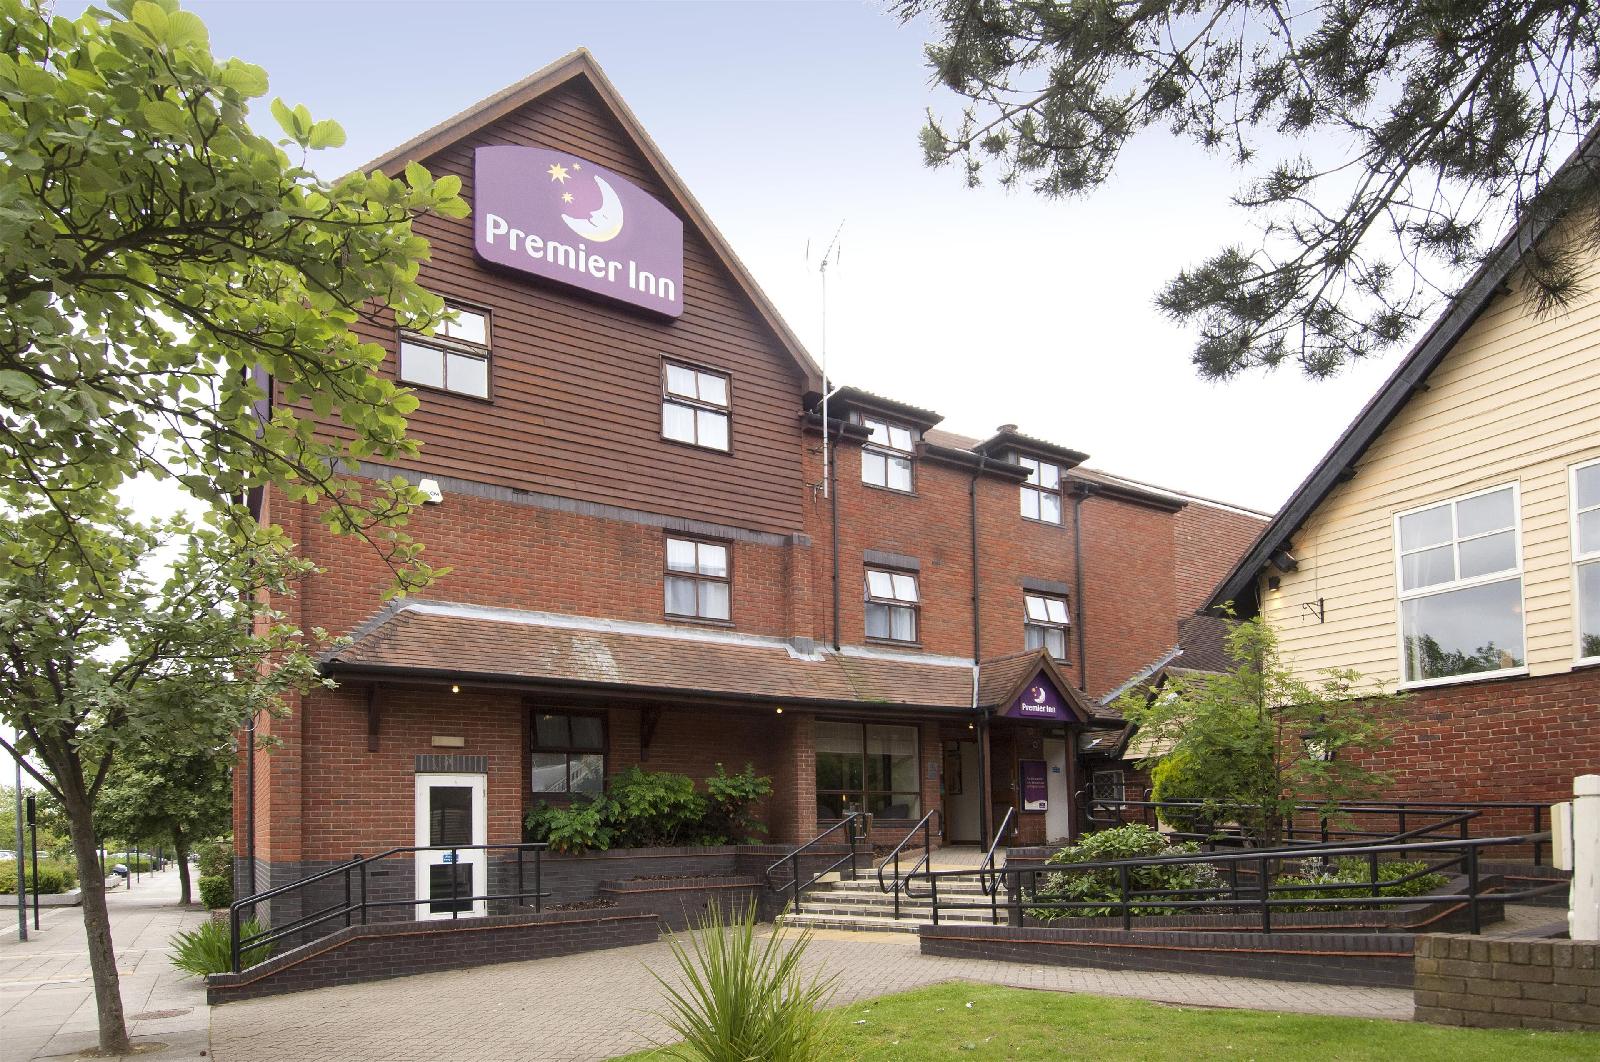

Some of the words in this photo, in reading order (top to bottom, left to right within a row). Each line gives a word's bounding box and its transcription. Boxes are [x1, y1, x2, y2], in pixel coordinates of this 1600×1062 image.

[486, 213, 623, 282] Premier
[629, 260, 675, 302] Inn
[1022, 702, 1046, 712] Premier
[1046, 705, 1056, 713] Inn
